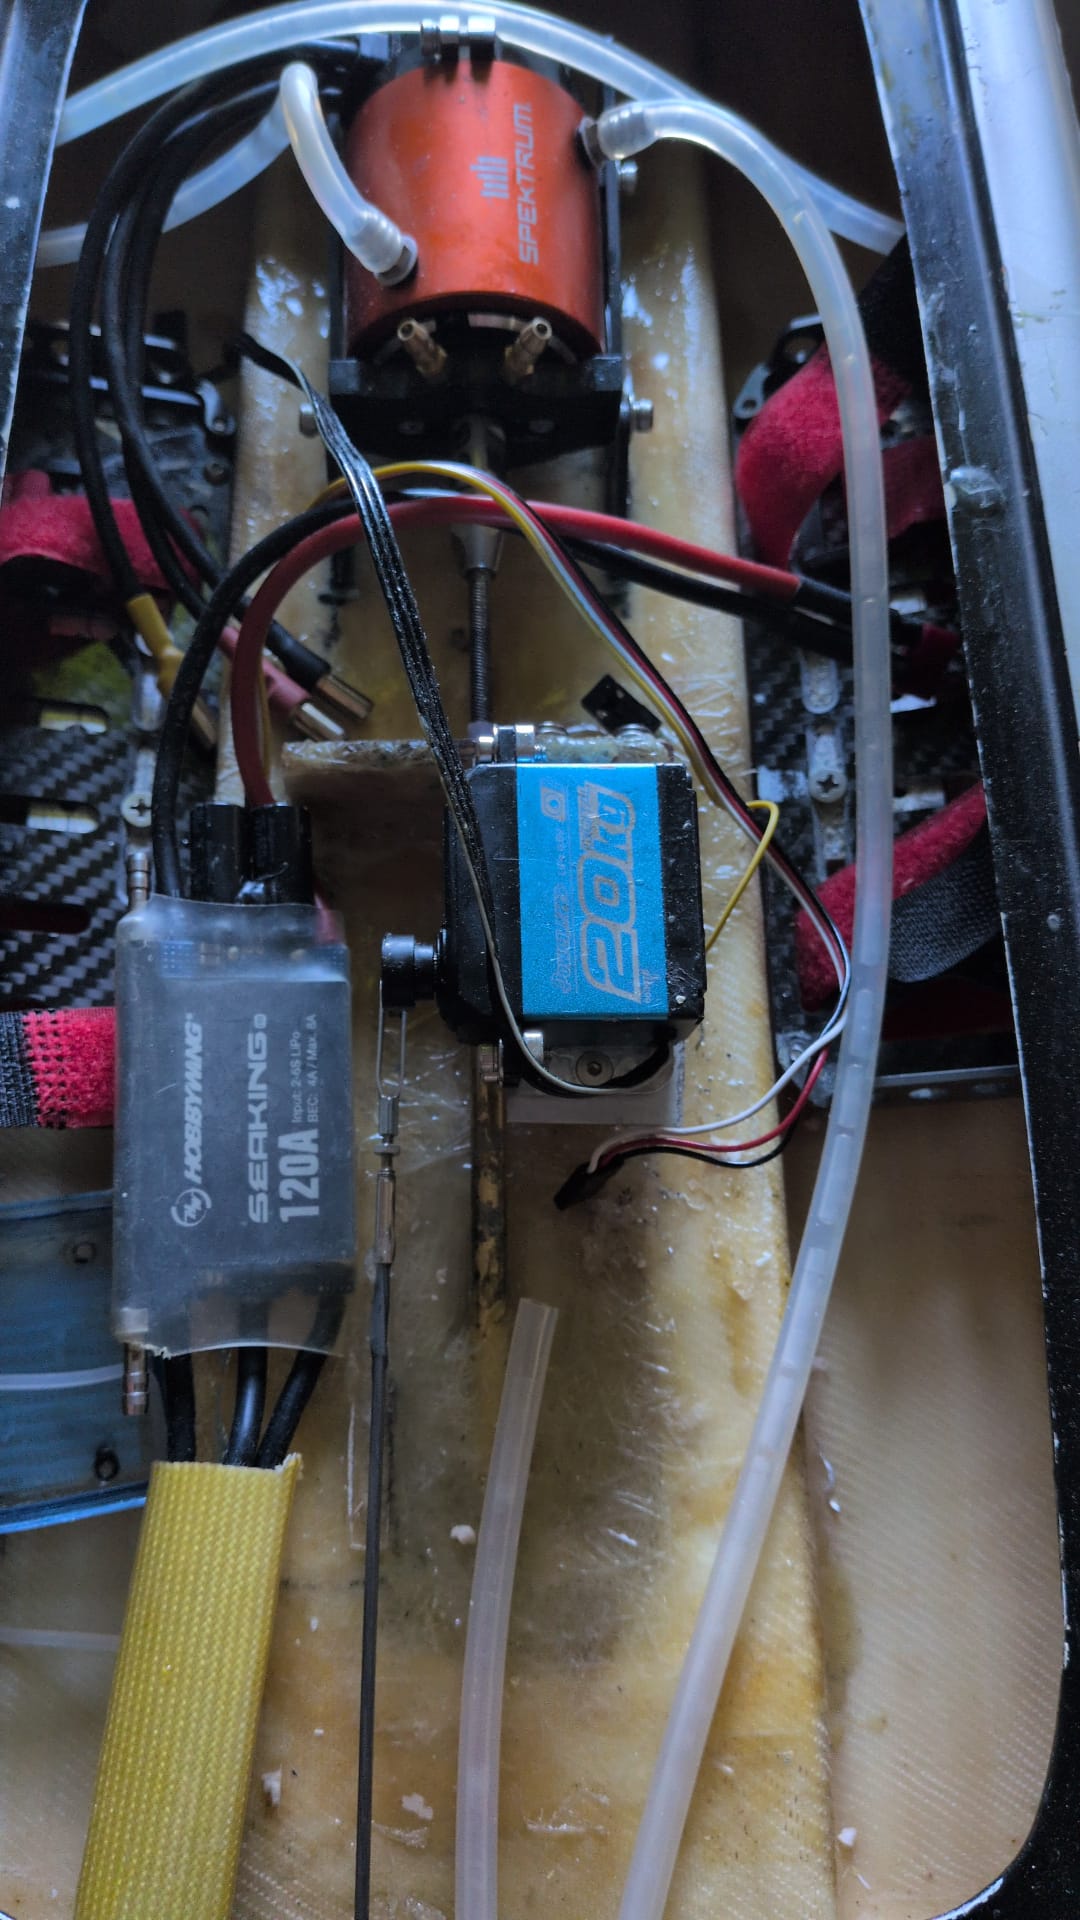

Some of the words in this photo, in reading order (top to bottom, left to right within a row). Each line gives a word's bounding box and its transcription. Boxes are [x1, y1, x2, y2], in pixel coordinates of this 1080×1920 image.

[514, 103, 539, 266] SPEKTRUM
[289, 1031, 301, 1057] LiPo
[248, 1032, 269, 1223] SEAKING
[291, 1090, 303, 1124] Input:
[278, 1128, 320, 1223] 120A
